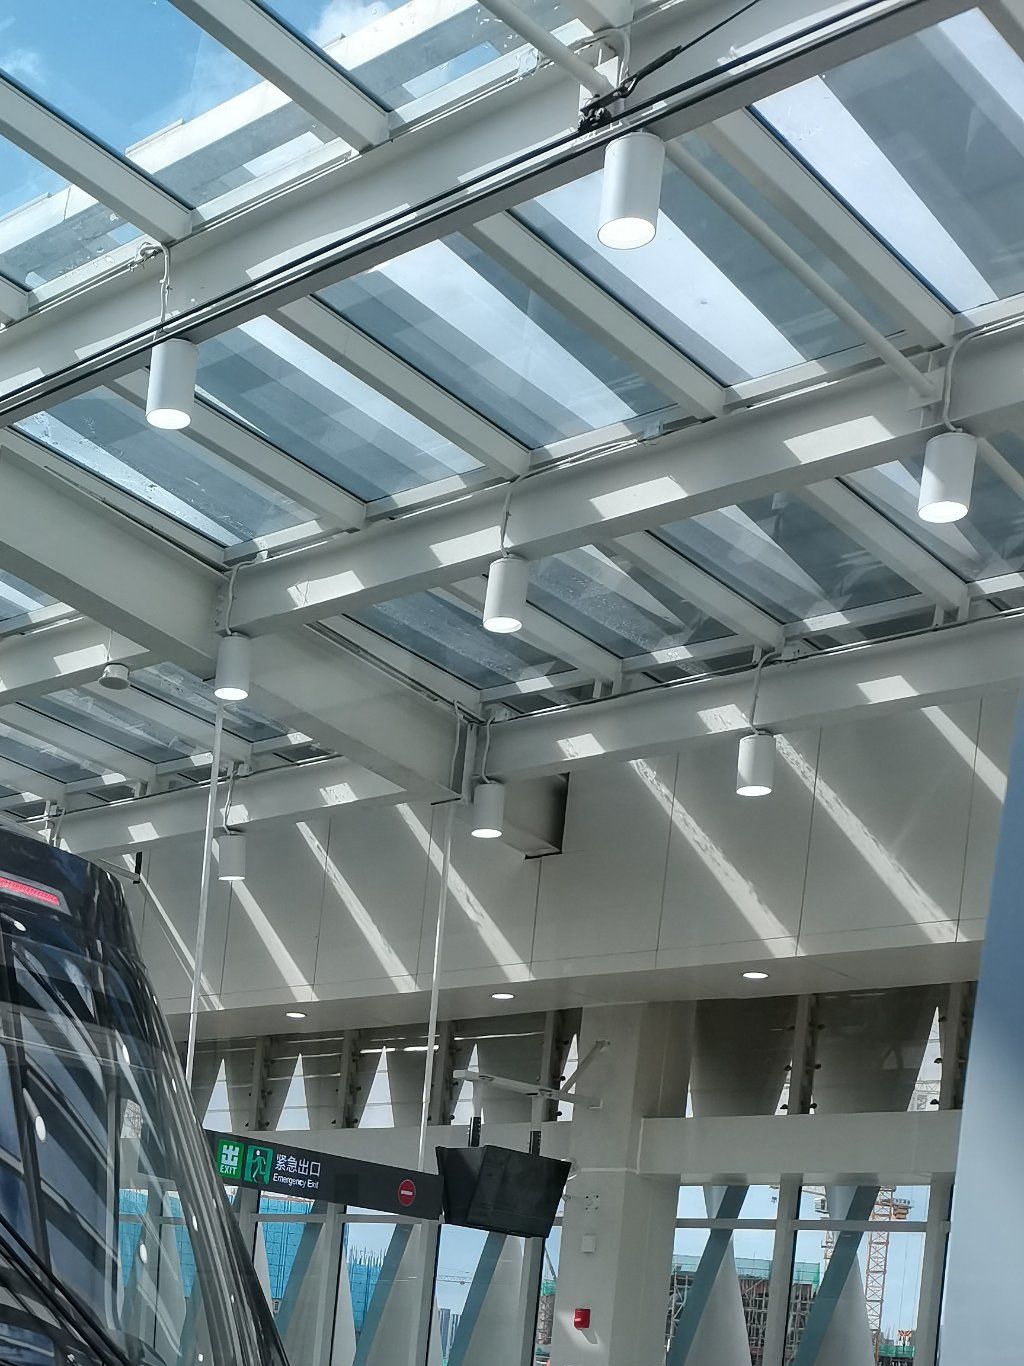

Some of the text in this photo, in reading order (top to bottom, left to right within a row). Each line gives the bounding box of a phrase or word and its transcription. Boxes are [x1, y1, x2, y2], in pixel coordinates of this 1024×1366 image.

[220, 1165, 237, 1175] EXIT
[275, 1153, 321, 1177] 紧急出口
[273, 1173, 306, 1188] Emergency
